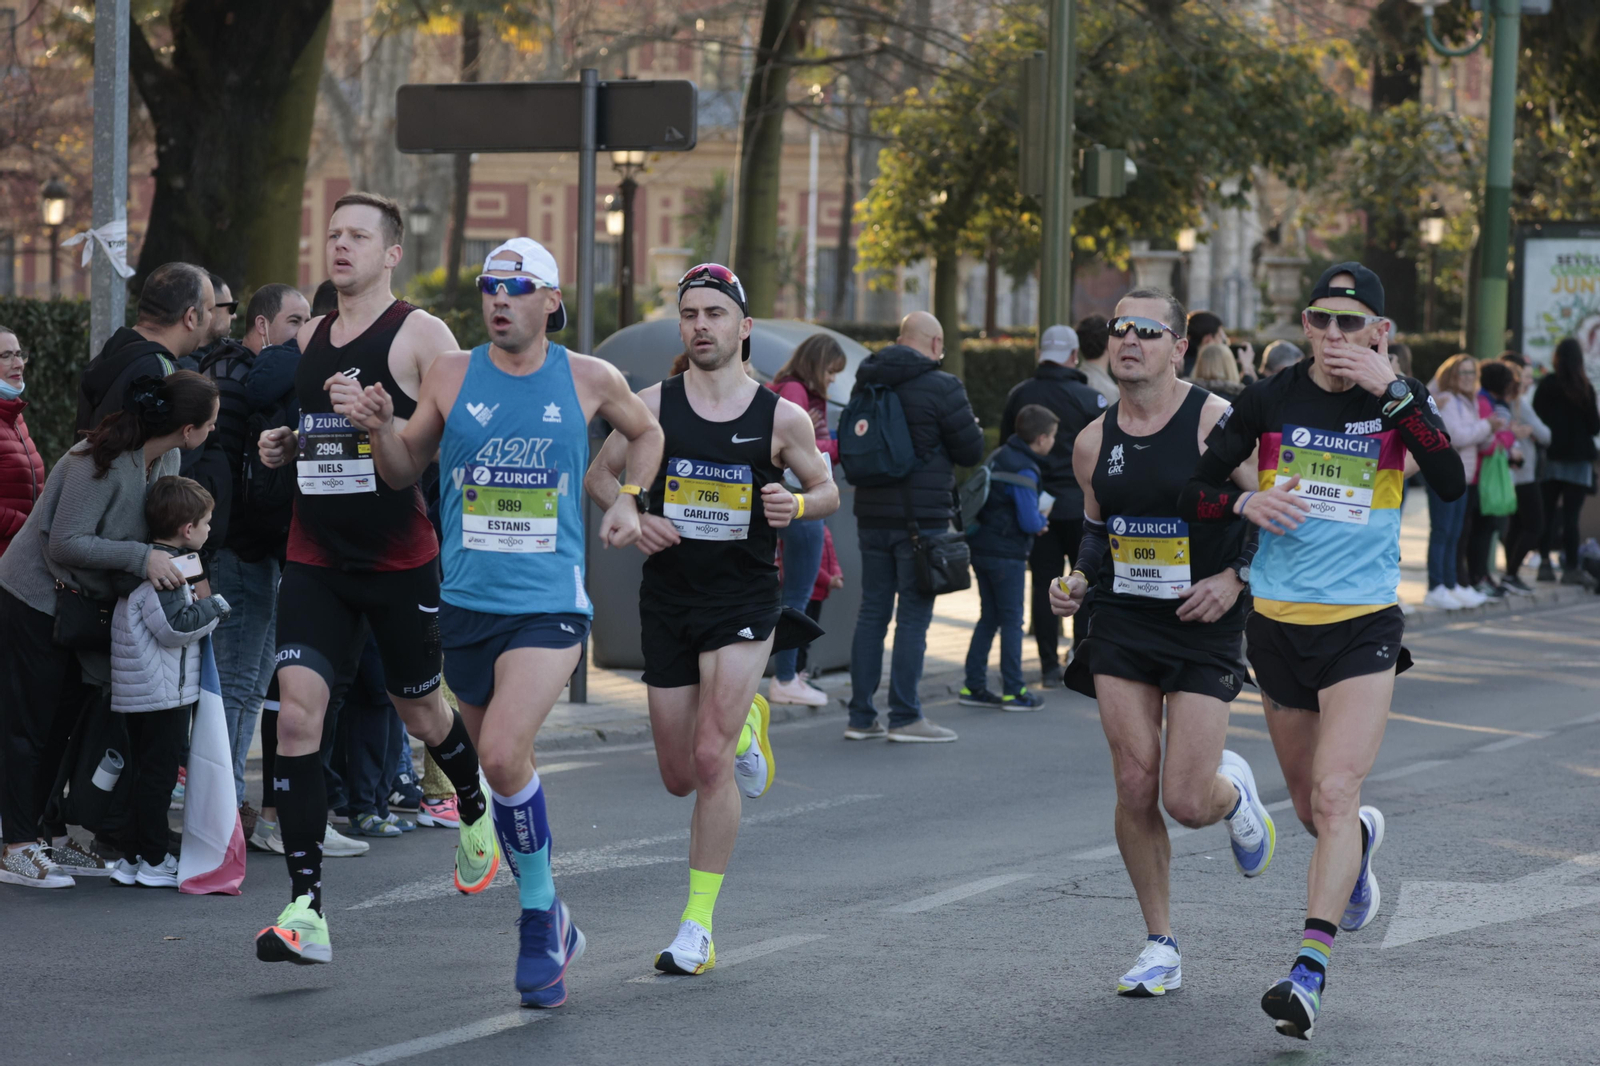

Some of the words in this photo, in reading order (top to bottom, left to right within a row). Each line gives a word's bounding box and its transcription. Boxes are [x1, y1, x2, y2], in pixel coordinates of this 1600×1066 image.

[316, 417, 354, 429] ZURIC
[316, 442, 343, 455] 2994
[1313, 434, 1369, 453] ZURICH
[476, 437, 553, 468] 42K
[318, 464, 343, 473] NIELS
[695, 465, 742, 479] ZURICH
[1311, 462, 1341, 478] 1161
[494, 472, 547, 484] ZURICH
[698, 490, 719, 502] 766
[1306, 484, 1341, 498] JORGE
[498, 498, 522, 512] 989
[684, 508, 729, 521] CARLITOS
[488, 520, 530, 532] ESTANIS
[1128, 522, 1176, 534] ZURICH
[1134, 548, 1155, 560] 609
[1130, 568, 1162, 578] DANIEL
[514, 809, 532, 854] OMPRESSPORT
